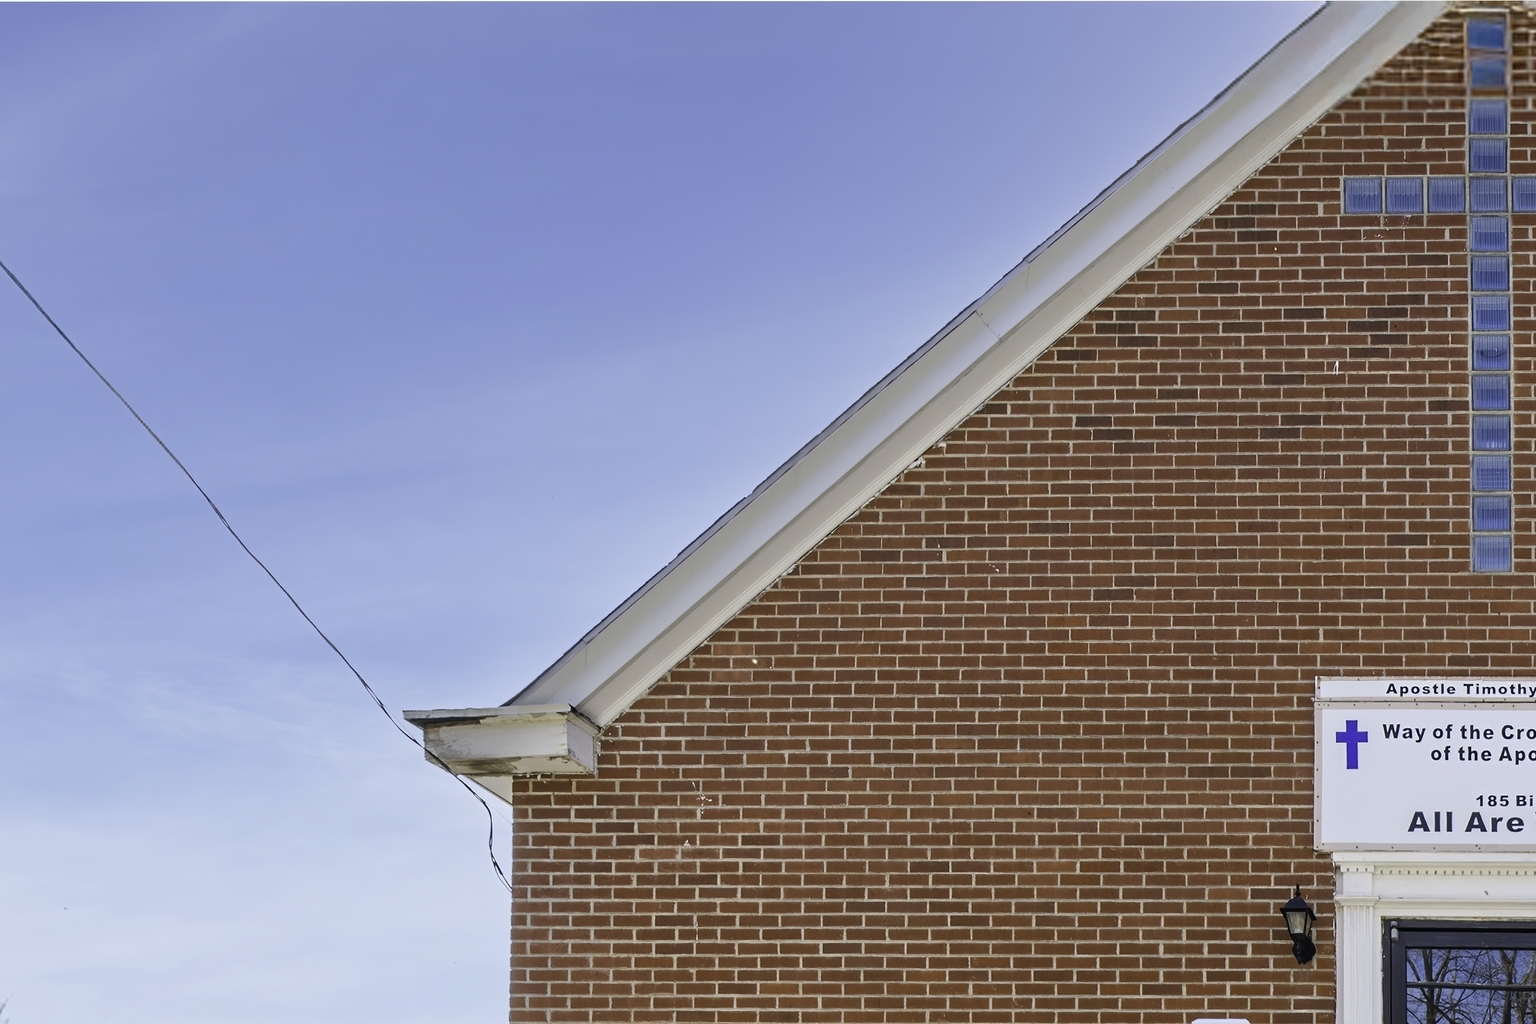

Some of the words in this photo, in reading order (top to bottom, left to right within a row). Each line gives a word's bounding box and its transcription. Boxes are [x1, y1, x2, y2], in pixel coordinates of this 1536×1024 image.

[1386, 683, 1456, 698] Apostle
[1382, 723, 1426, 743] Way
[1432, 724, 1453, 740] of
[1460, 724, 1494, 740] the
[1430, 746, 1451, 761] of
[1457, 746, 1492, 762] the
[1476, 794, 1510, 807] 185
[1407, 811, 1453, 833] All
[1464, 811, 1525, 833] Are
